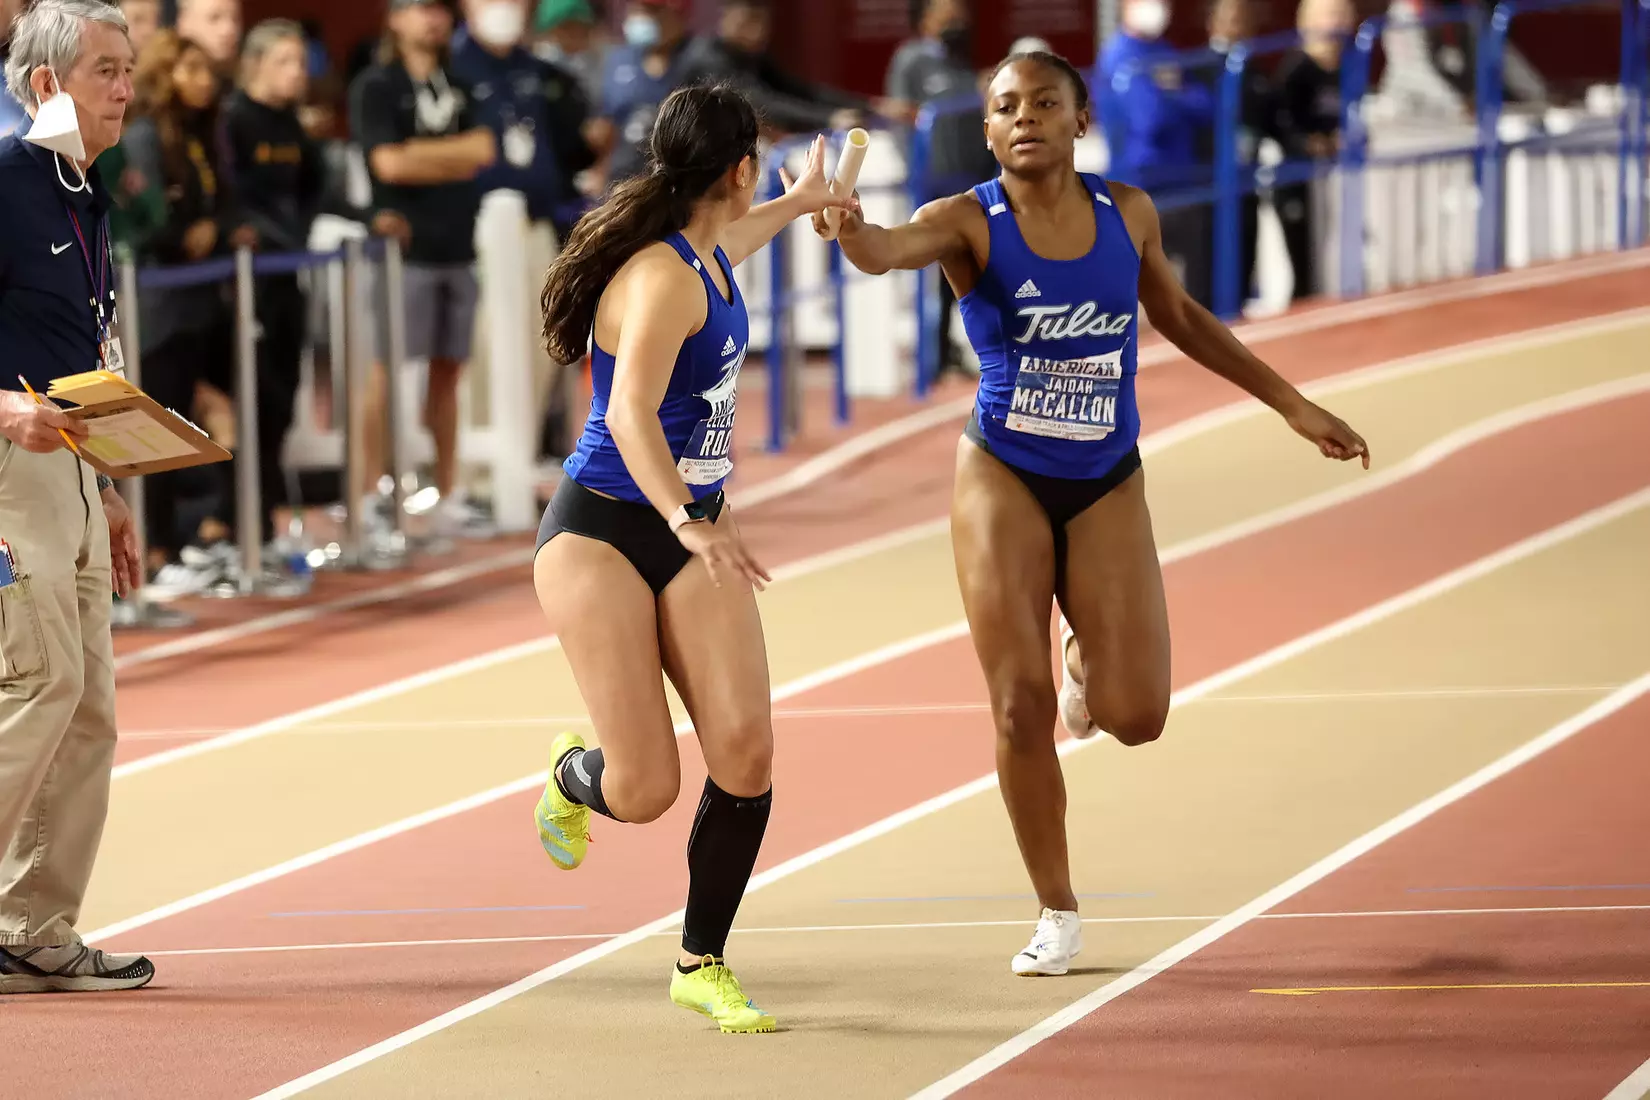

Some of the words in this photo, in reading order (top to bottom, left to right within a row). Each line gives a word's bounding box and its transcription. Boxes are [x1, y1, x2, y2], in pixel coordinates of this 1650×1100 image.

[1015, 290, 1041, 299] adidas
[1013, 301, 1133, 344] Tulsa
[1024, 359, 1115, 377] AMERICAN
[1045, 377, 1093, 394] JAIDAH
[1011, 386, 1116, 424] MCCALLON
